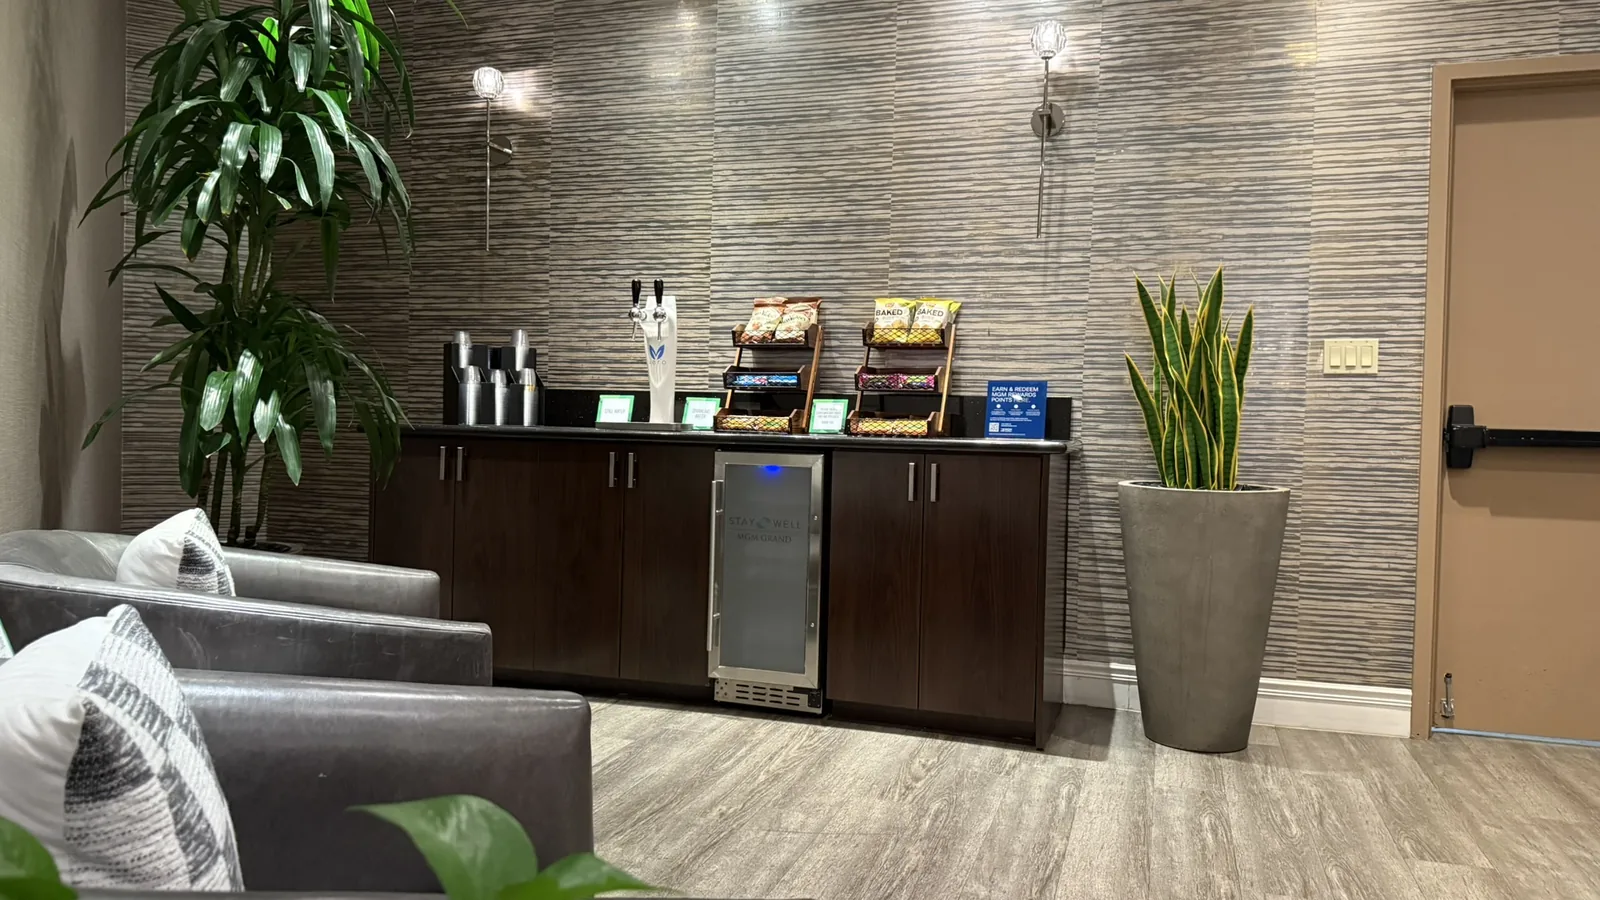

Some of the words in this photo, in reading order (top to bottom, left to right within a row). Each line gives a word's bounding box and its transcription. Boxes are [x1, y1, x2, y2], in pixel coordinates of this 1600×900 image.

[875, 308, 903, 316] BAKED
[917, 308, 944, 317] BAKED
[728, 516, 756, 527] STAY
[772, 519, 801, 530] WELL
[737, 532, 759, 542] MGM
[760, 533, 792, 543] GRAND
